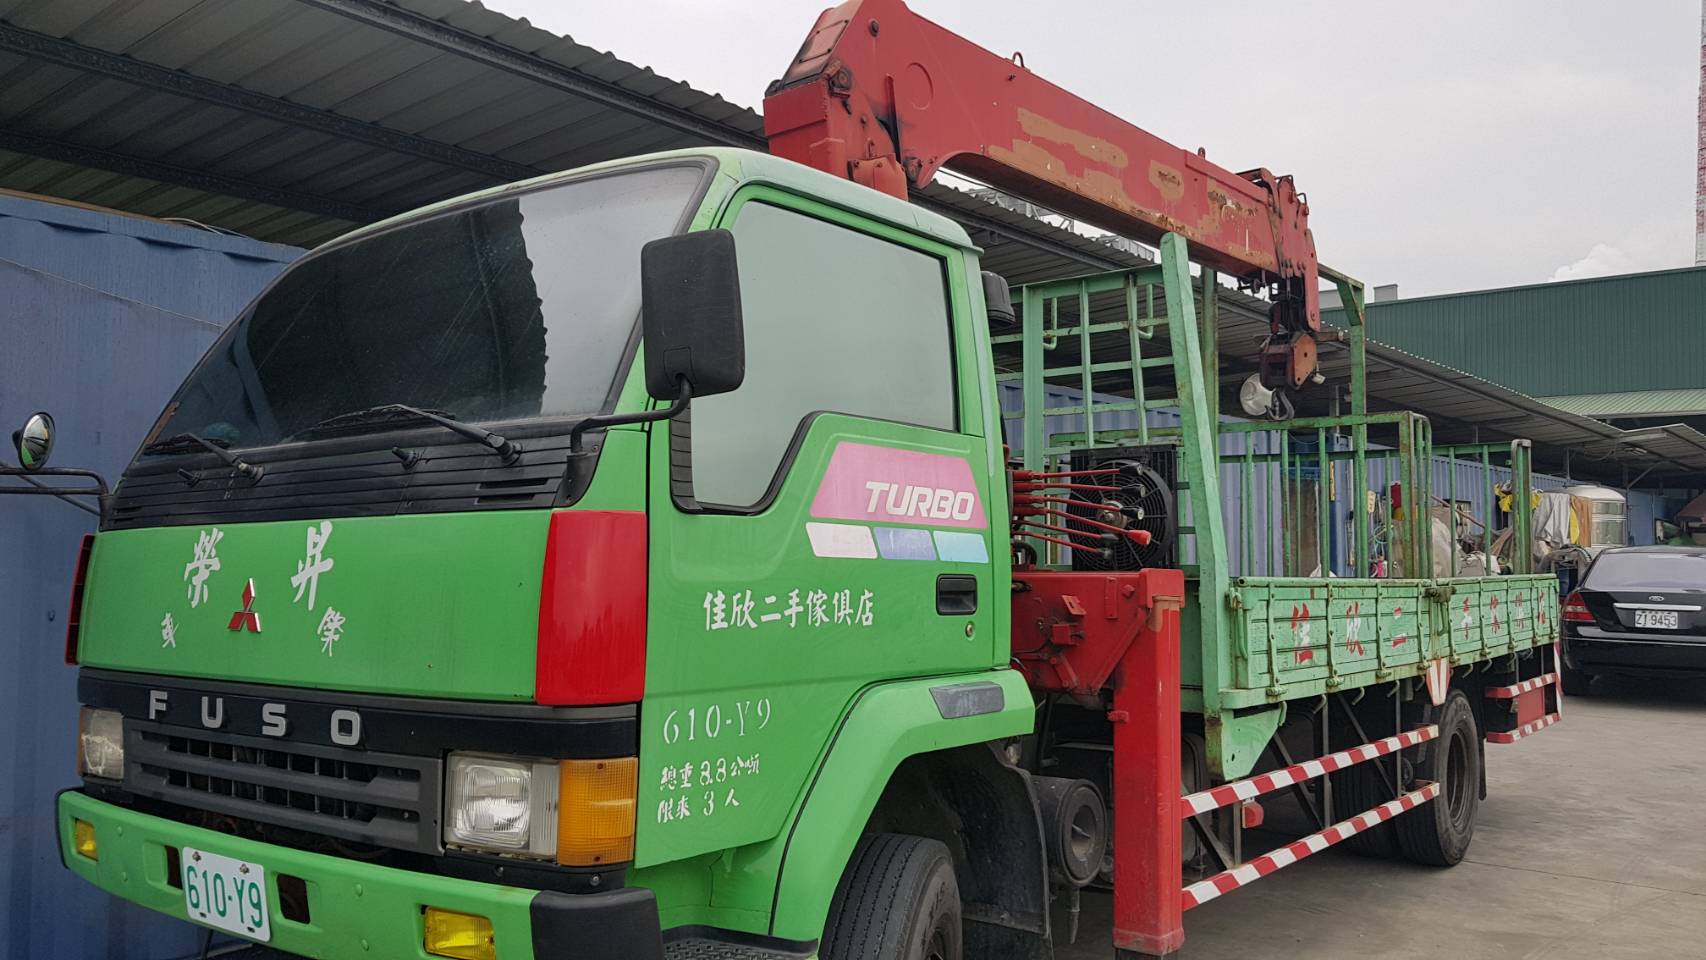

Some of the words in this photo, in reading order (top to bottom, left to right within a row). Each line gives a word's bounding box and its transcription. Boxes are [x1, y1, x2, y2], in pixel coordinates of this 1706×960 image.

[865, 480, 975, 521] TURBO
[703, 588, 874, 631] 佳欣二手傢俱店
[149, 689, 361, 746] FUSO
[664, 698, 771, 744] 610-Y9
[187, 865, 263, 928] 610-Y9
